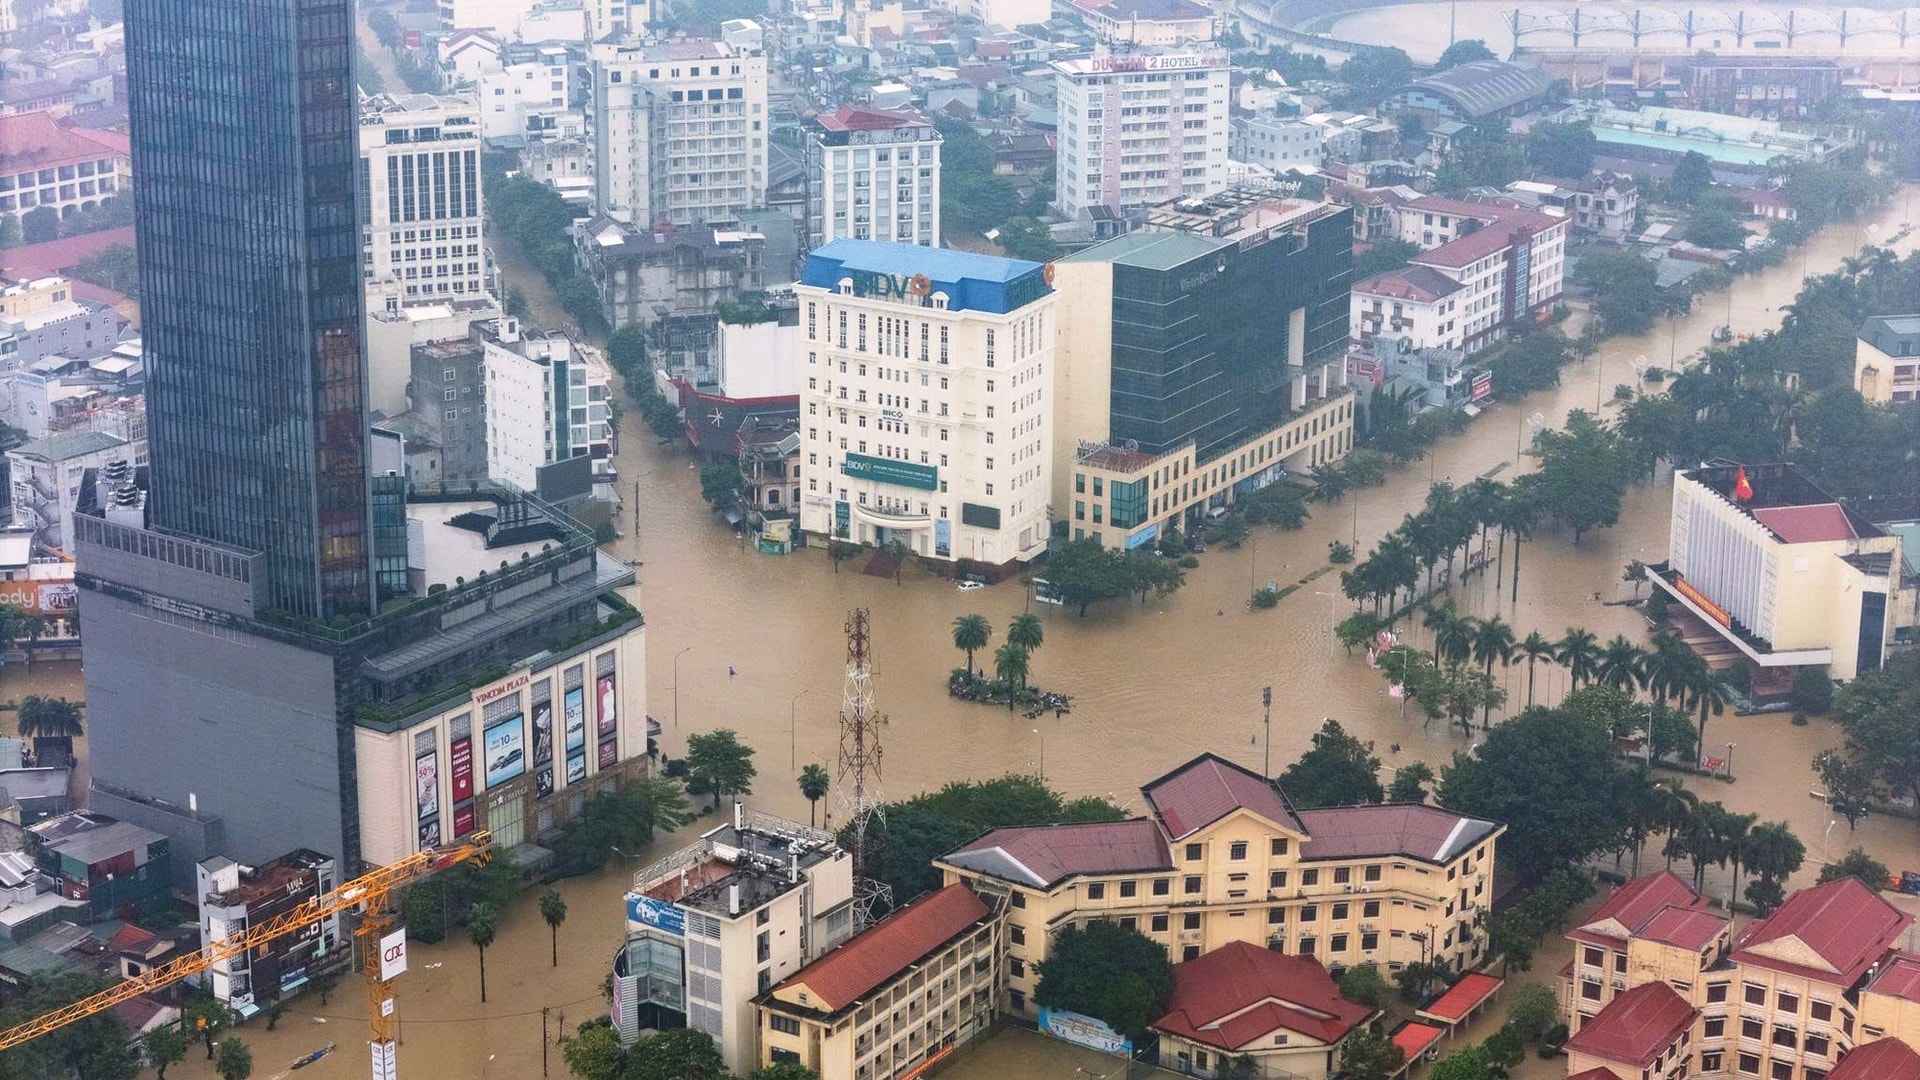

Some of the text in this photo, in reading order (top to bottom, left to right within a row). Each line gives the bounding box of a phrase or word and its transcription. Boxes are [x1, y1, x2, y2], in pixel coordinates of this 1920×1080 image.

[1149, 58, 1157, 69] 2
[1161, 57, 1198, 68] HOTEL
[359, 117, 385, 126] ORA
[847, 460, 866, 471] BIDV
[0, 587, 35, 609] ody
[476, 675, 530, 704] VINCOM PLAZA
[566, 709, 575, 719] 10
[501, 734, 510, 746] 10
